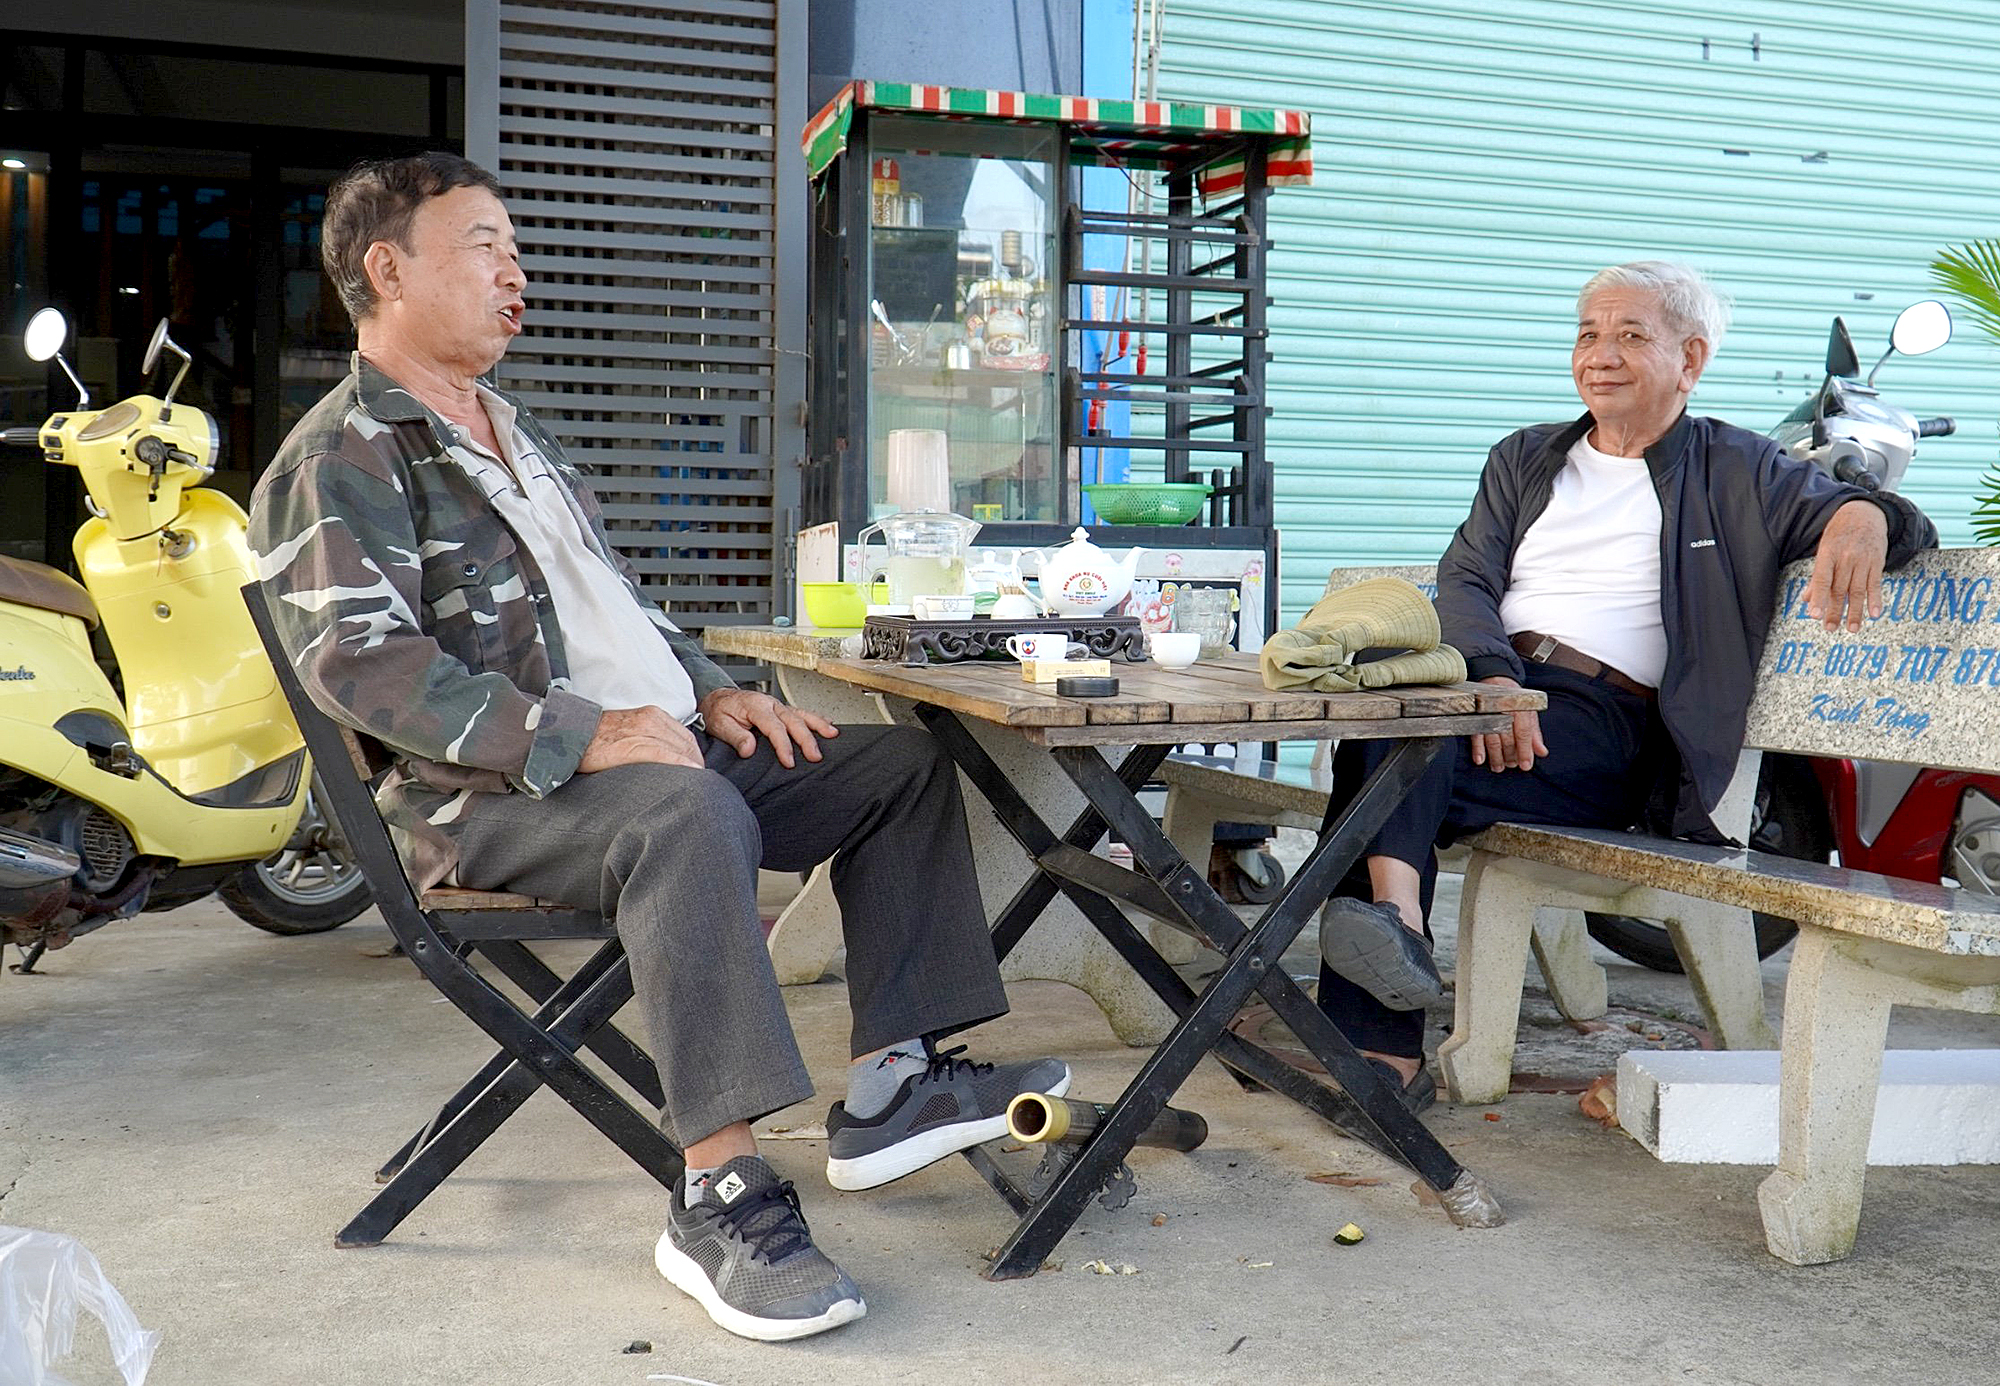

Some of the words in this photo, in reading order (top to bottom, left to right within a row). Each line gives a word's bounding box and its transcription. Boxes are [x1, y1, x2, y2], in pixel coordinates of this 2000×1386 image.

[1690, 539, 1716, 548] adidas
[1824, 643, 1889, 679] 0879
[1894, 645, 1949, 682] 707
[725, 1184, 743, 1200] adidas
